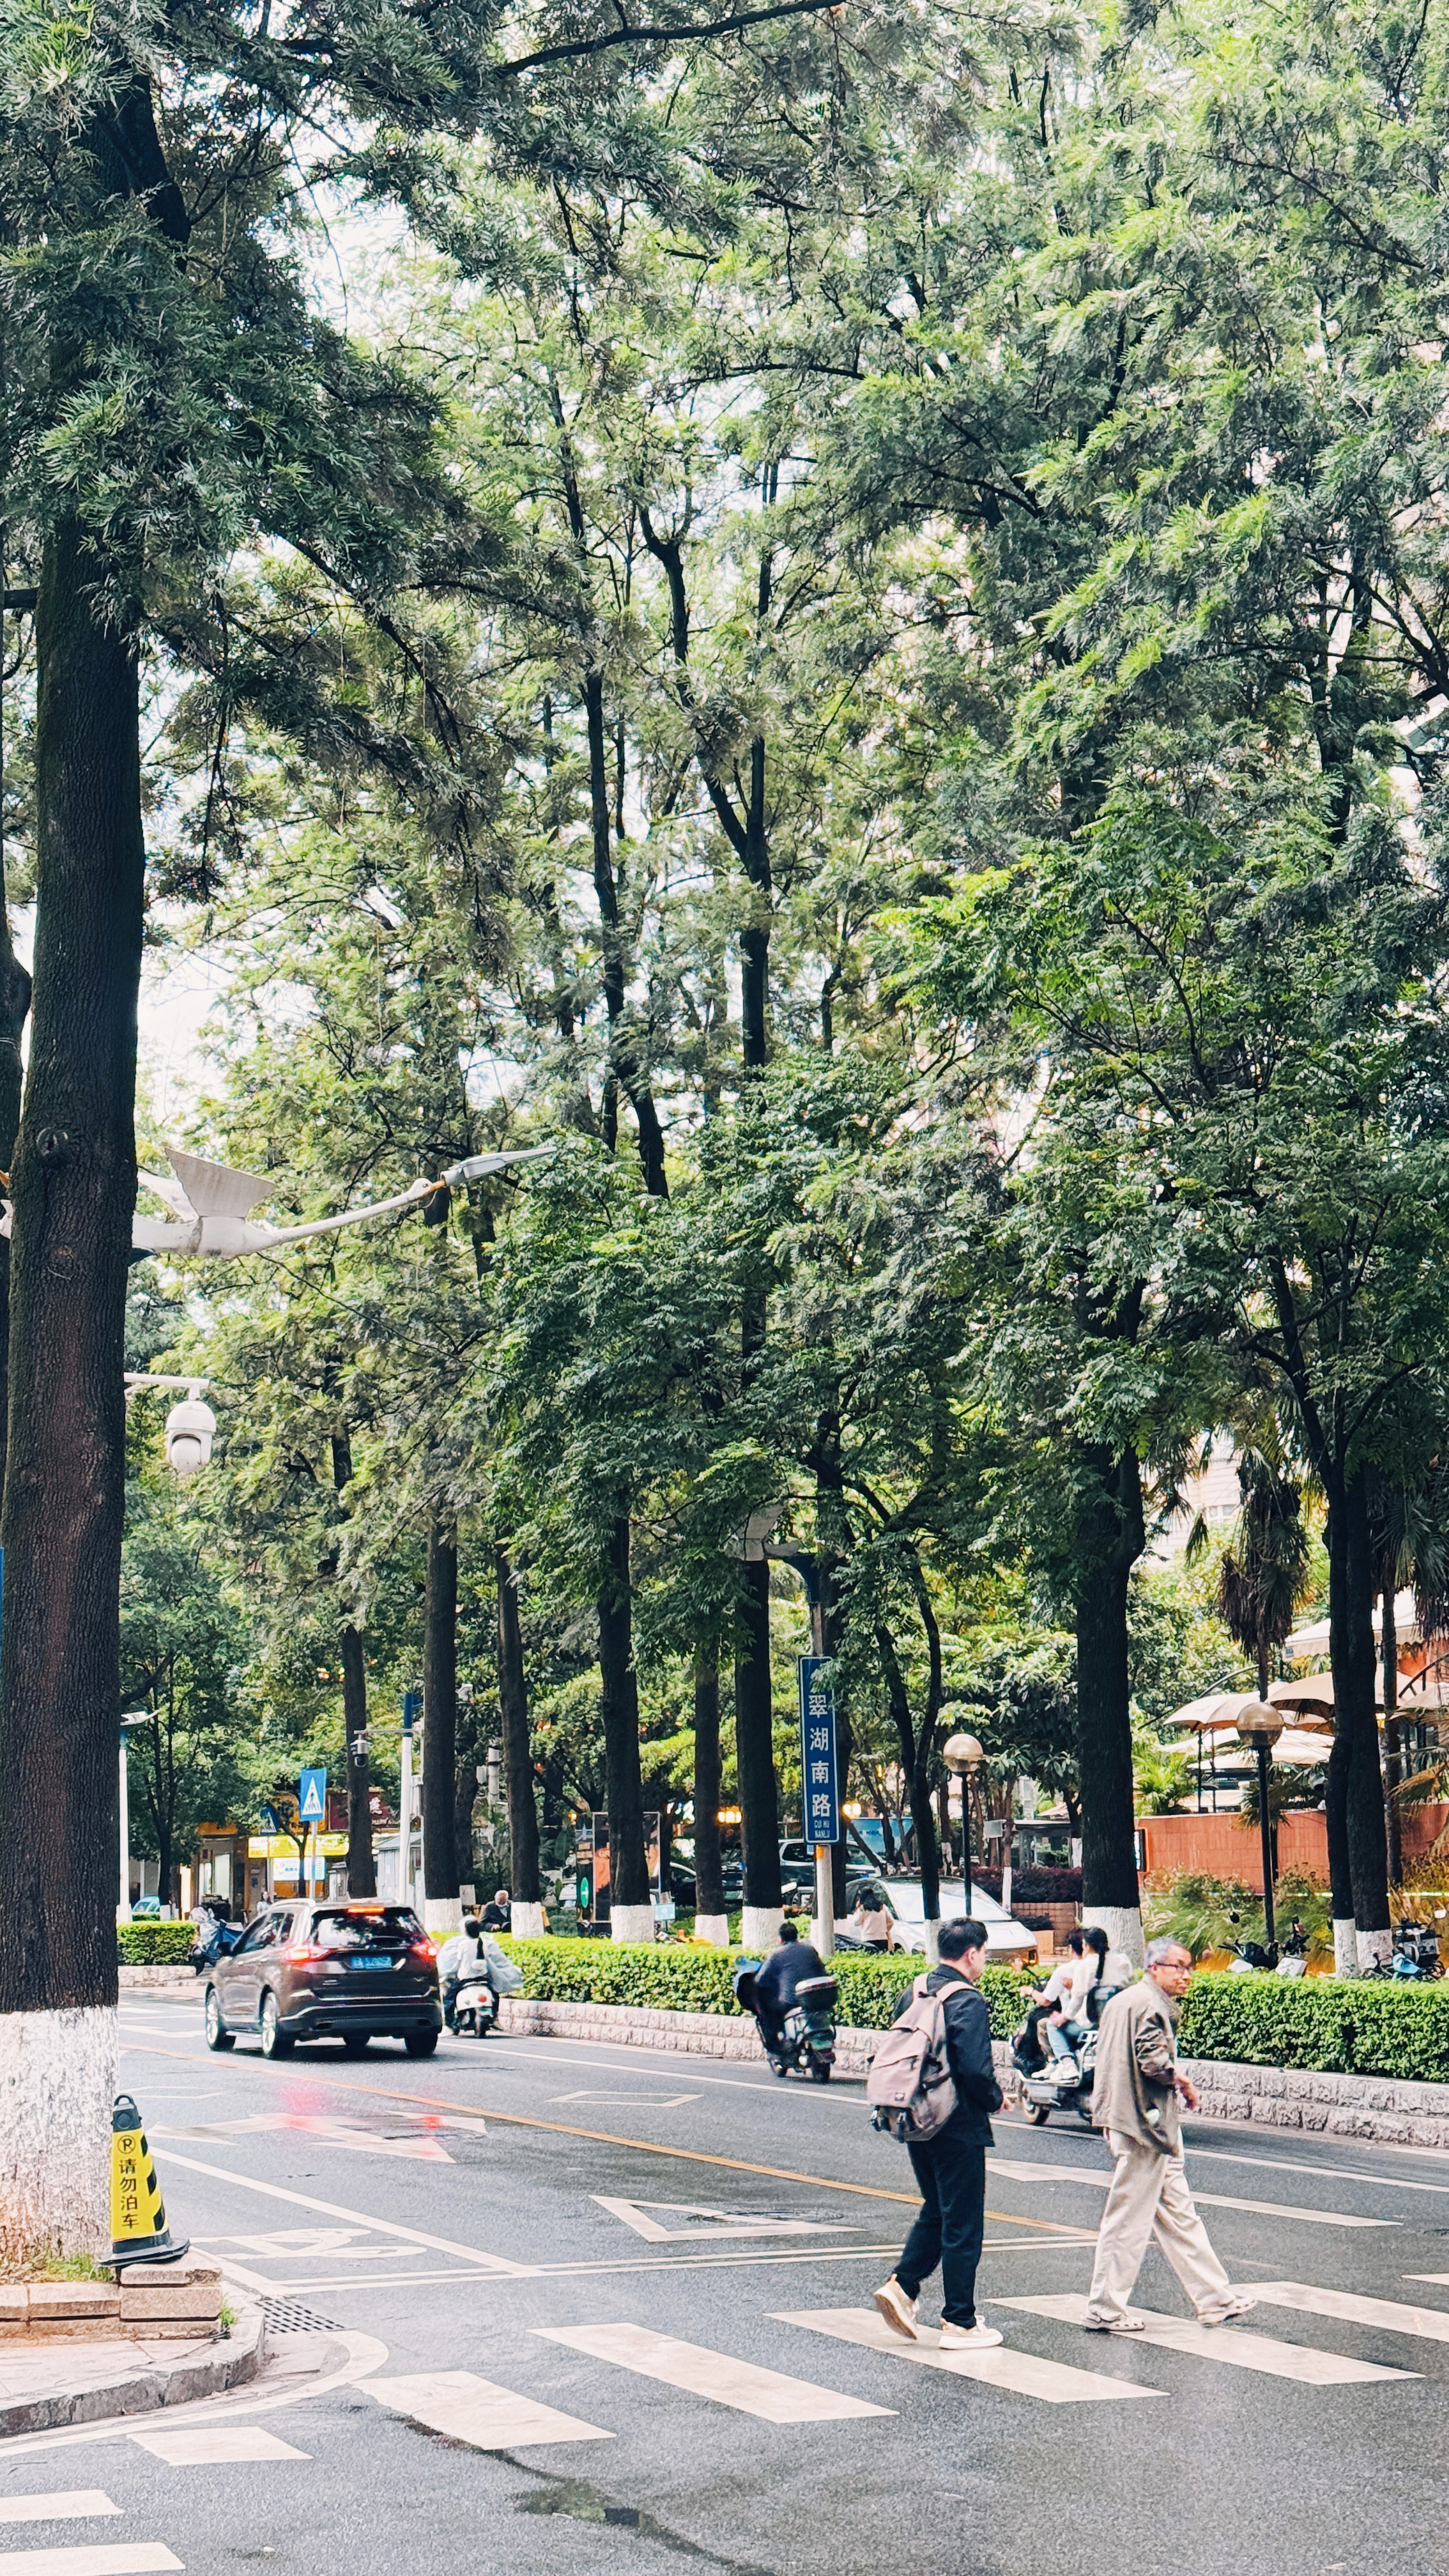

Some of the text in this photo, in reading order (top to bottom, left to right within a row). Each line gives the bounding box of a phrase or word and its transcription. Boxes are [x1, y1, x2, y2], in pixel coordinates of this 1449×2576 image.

[808, 1694, 831, 1818] 翠湖南路
[118, 2158, 139, 2229] 请勿泊车
